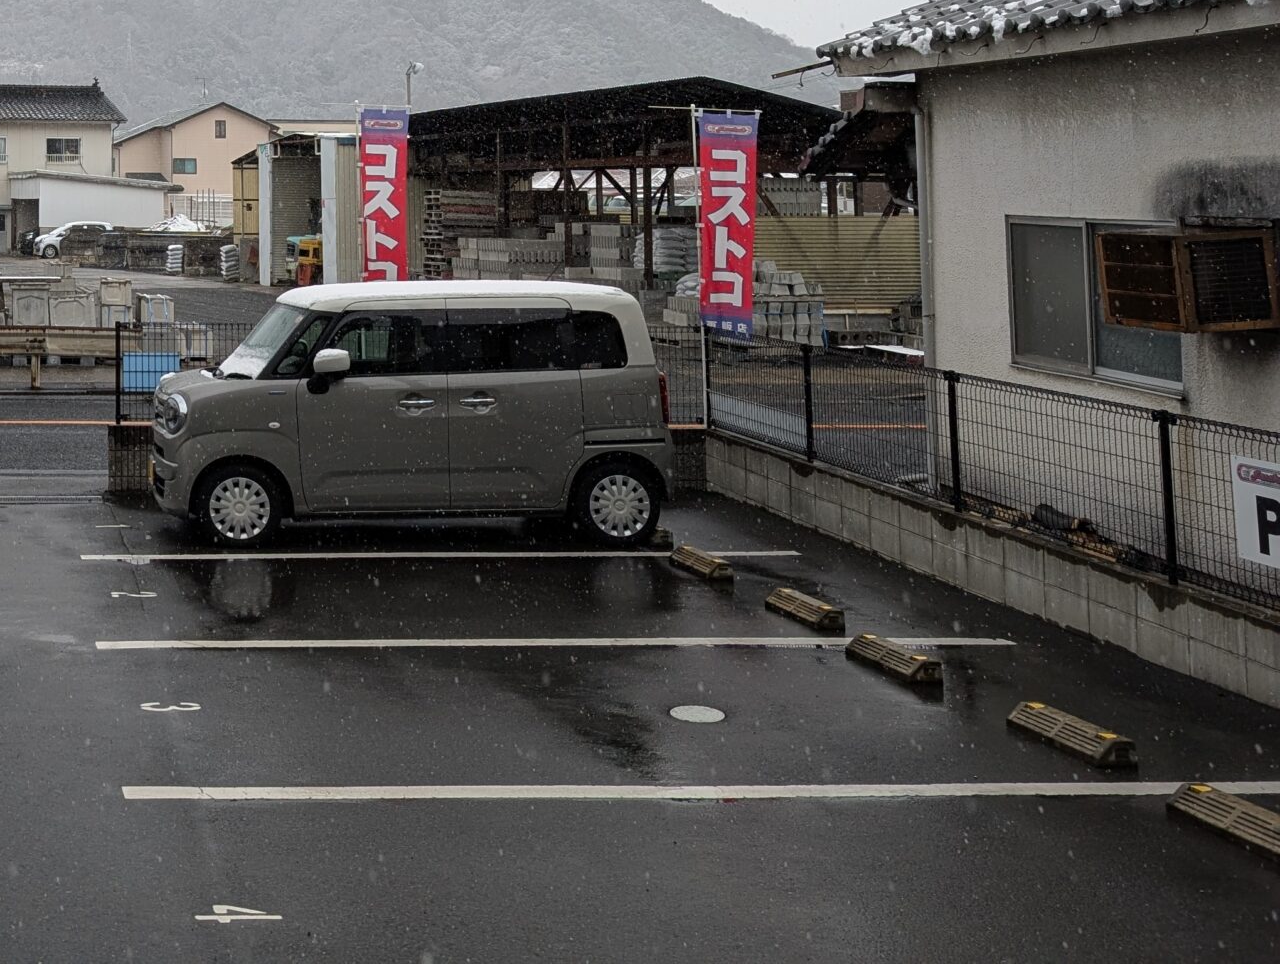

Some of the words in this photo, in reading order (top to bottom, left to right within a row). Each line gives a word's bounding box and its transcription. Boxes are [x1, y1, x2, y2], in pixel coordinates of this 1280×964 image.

[707, 149, 751, 308] コストコ
[1256, 495, 1280, 556] P
[140, 701, 202, 712] 3
[194, 904, 283, 924] 4
